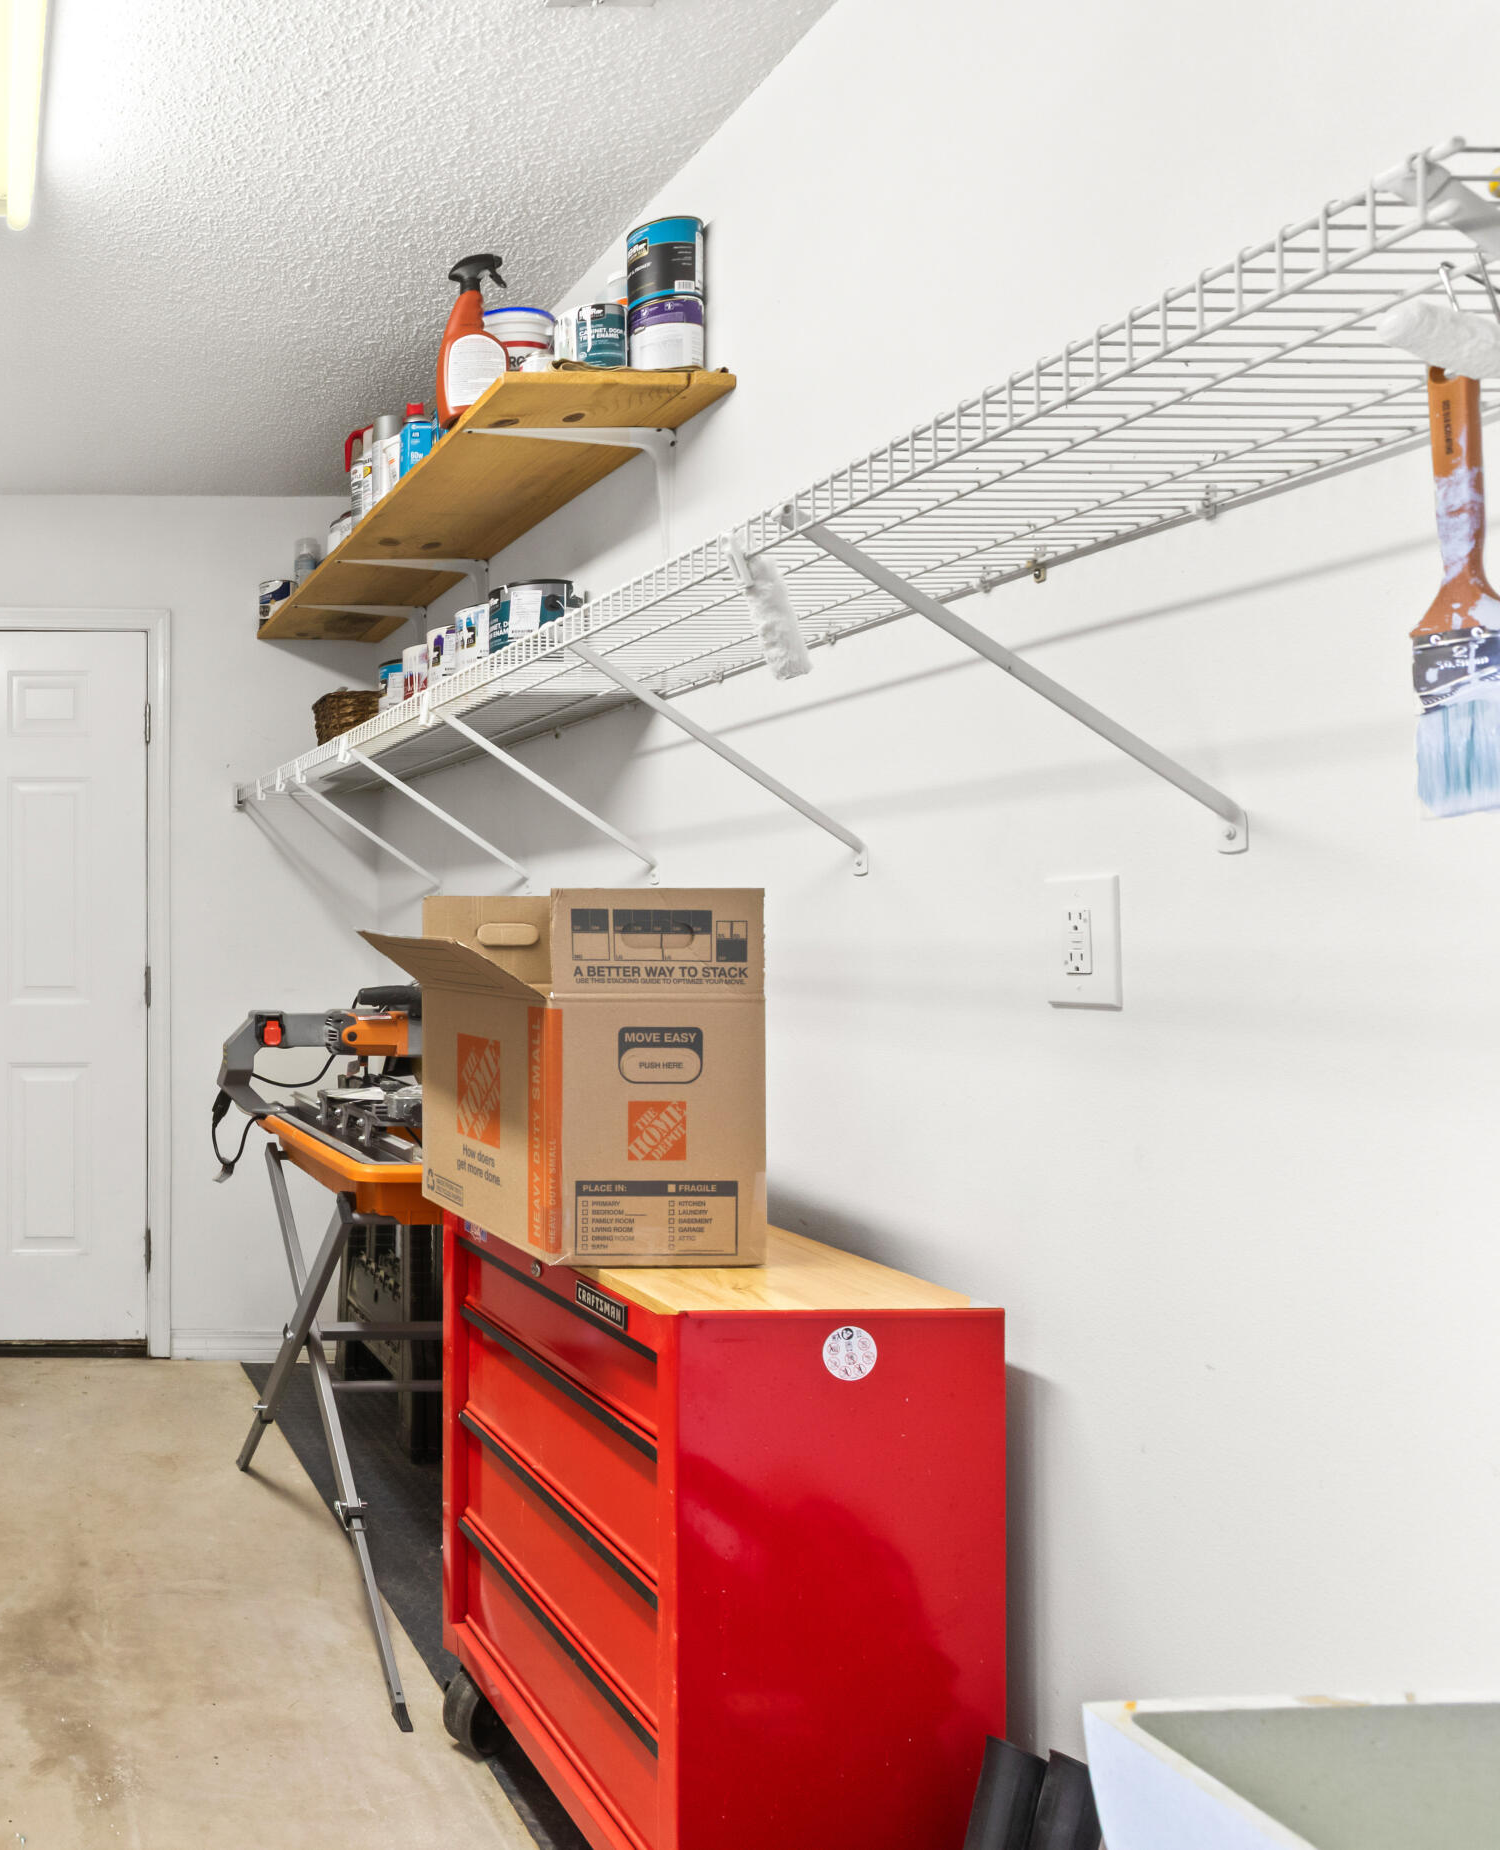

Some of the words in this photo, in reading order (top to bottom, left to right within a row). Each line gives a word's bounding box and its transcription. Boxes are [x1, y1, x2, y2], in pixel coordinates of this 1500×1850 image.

[573, 966, 583, 977] A
[587, 966, 641, 978] BETTER
[644, 966, 675, 978] WAY
[679, 966, 698, 978] TO
[702, 966, 749, 978] STACK
[624, 1032, 661, 1043] MOVE
[664, 1032, 697, 1043] EASY
[461, 1045, 480, 1083] THE
[531, 1017, 541, 1100] SMALL
[639, 1061, 661, 1069] PUSH
[662, 1061, 684, 1069] HERE
[457, 1037, 500, 1135] HOME
[473, 1082, 500, 1141] DEPOT
[634, 1106, 658, 1131] THE
[531, 1111, 541, 1164] DUTY
[627, 1101, 686, 1160] HOME
[651, 1123, 686, 1160] DEPOT
[457, 1159, 467, 1171] get
[467, 1163, 484, 1178] more
[462, 1144, 476, 1159] How
[477, 1150, 495, 1168] doers
[547, 1138, 557, 1174] SMALL
[531, 1171, 542, 1238] HEAVY
[547, 1177, 557, 1206] DUTY
[582, 1184, 612, 1192] PLACE
[615, 1184, 627, 1192] IN:
[678, 1184, 717, 1192] FRAGILE
[547, 1210, 557, 1244] HEAVY
[578, 1287, 621, 1322] CRAFTSMAN
